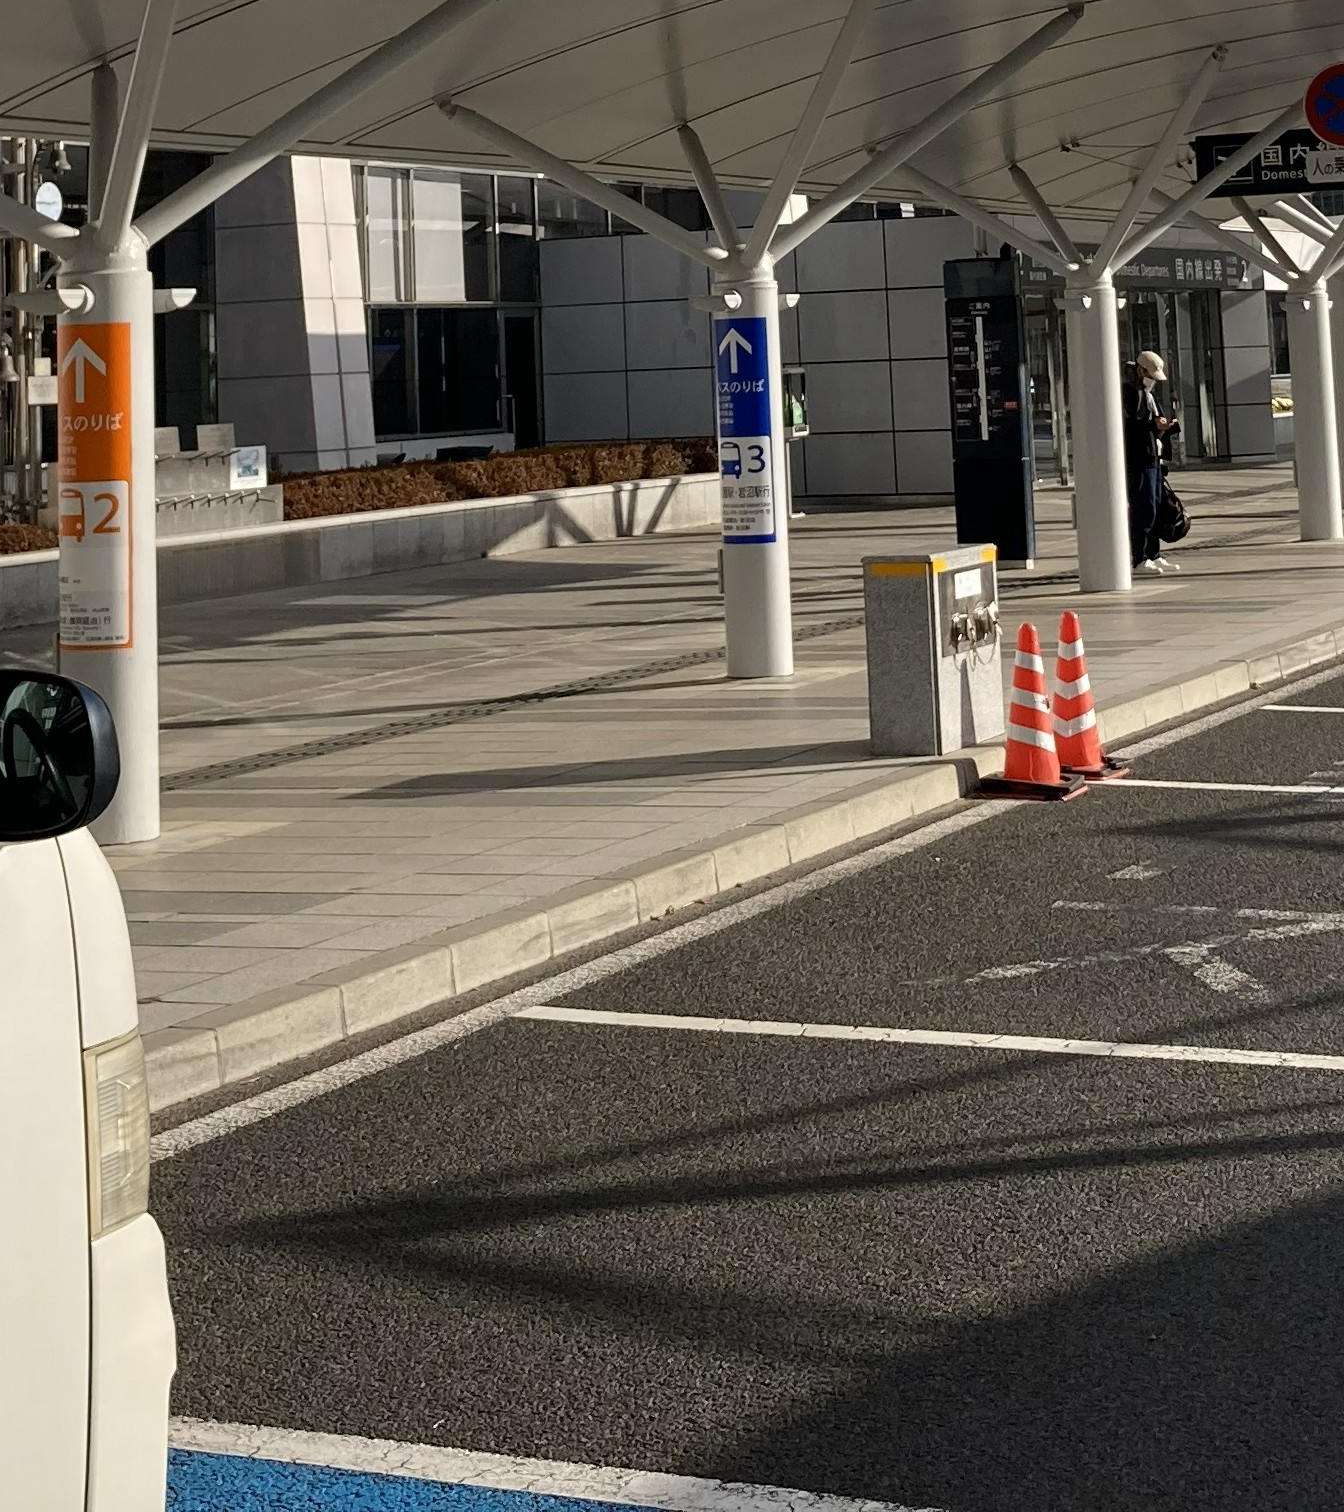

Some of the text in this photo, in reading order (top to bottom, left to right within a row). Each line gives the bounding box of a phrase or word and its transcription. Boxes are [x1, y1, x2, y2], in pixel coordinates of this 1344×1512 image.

[62, 412, 124, 432] スのりば
[747, 444, 766, 473] 3
[93, 492, 121, 535] 2
